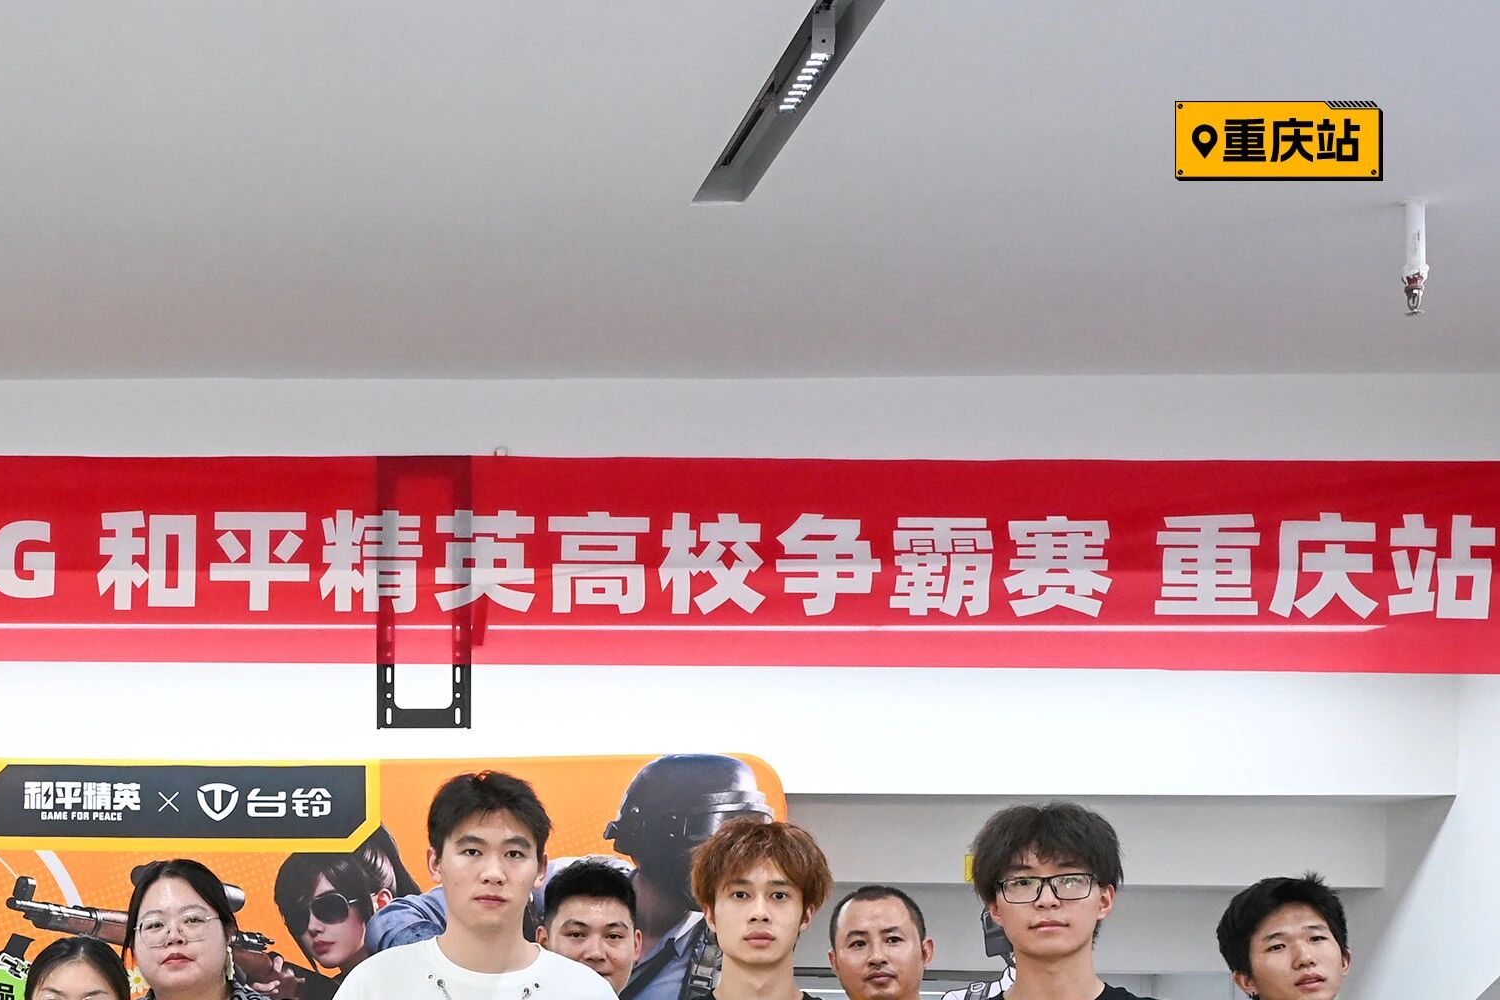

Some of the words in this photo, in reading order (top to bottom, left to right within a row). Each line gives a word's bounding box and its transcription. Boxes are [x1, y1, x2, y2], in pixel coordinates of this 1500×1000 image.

[96, 509, 1113, 617] 和平精英高校争霸赛
[1153, 512, 1496, 620] 重庆站
[23, 781, 142, 811] 和平精英
[246, 787, 333, 818] 台铃
[41, 811, 69, 821] GAME
[71, 811, 90, 821] FOR
[92, 811, 123, 821] PEACE
